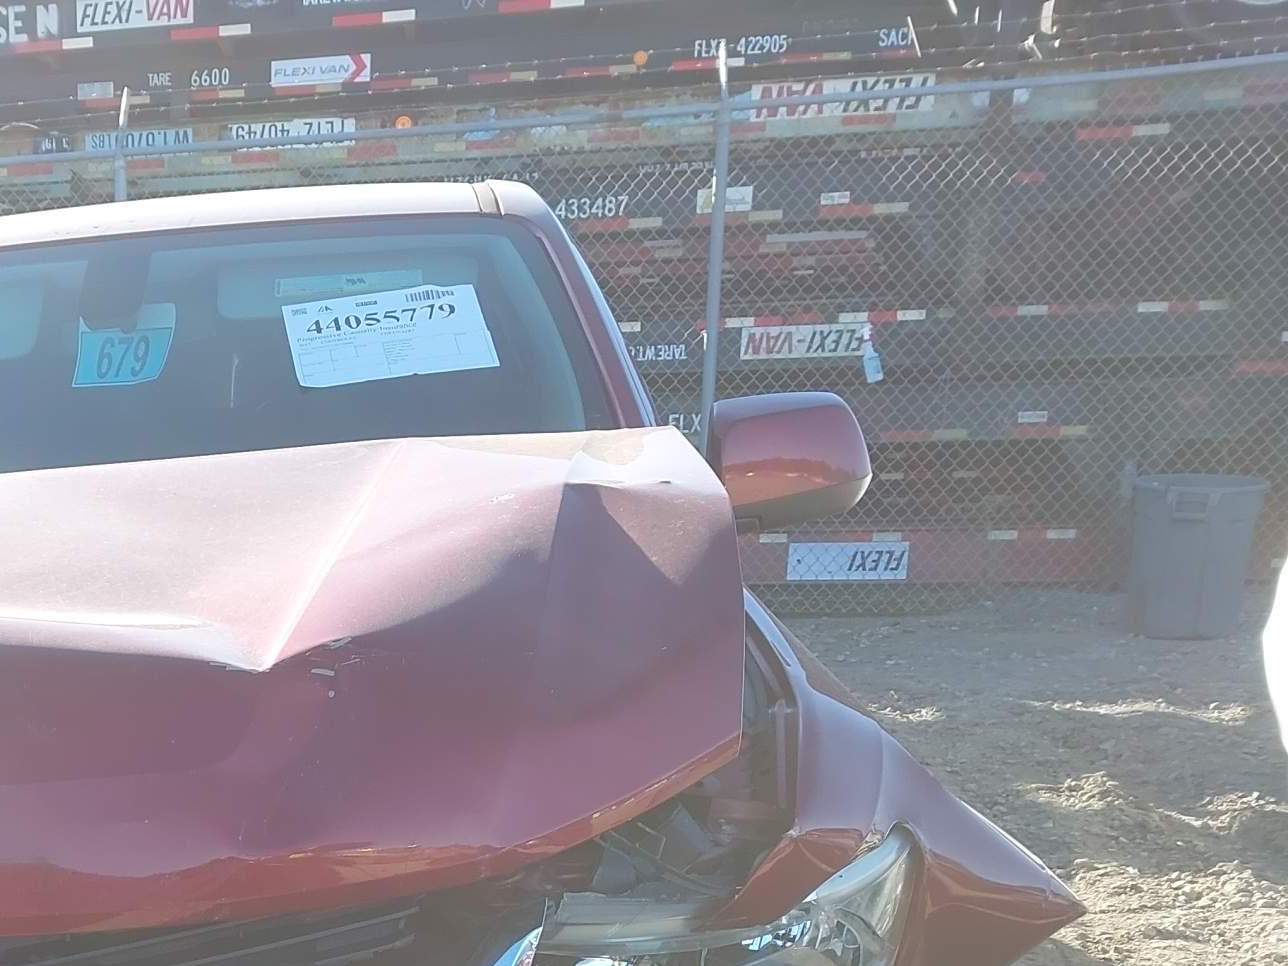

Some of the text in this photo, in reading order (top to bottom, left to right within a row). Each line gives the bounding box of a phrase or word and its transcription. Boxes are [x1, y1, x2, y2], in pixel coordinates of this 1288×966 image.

[147, 68, 230, 87] TARE 6600
[306, 303, 456, 334] 44055779
[96, 335, 150, 379] 679
[847, 550, 907, 572] FLEXI
